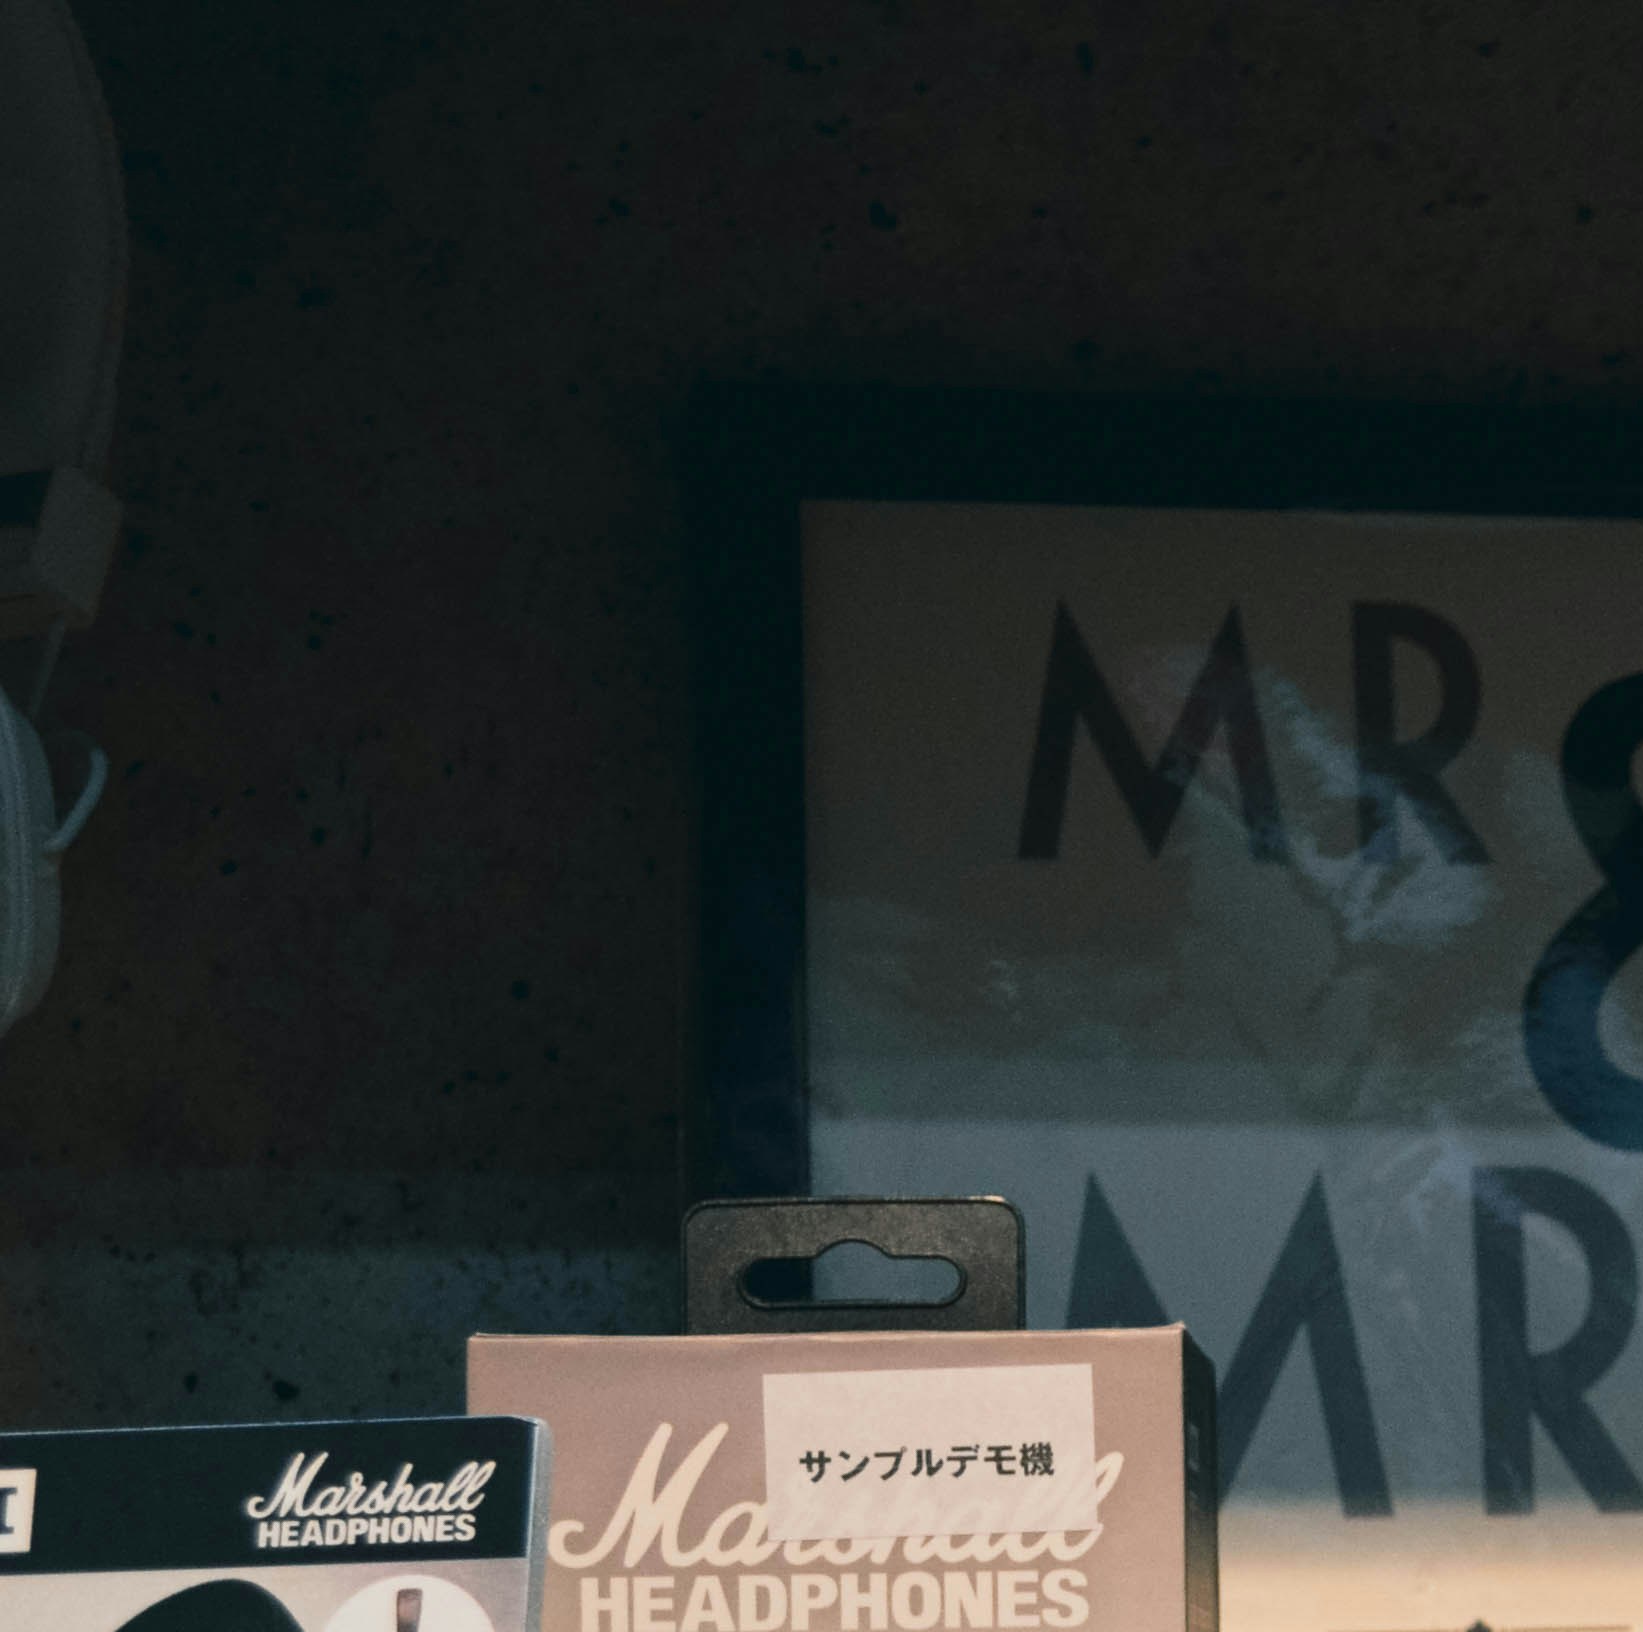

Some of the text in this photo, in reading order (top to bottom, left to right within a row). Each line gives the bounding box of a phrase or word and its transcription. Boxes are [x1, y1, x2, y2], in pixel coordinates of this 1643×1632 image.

[1016, 599, 1493, 864] MR
[247, 1451, 496, 1518] Marshall
[799, 1441, 1055, 1483] サンプルデモ機
[257, 1515, 477, 1549] HEADPHONES
